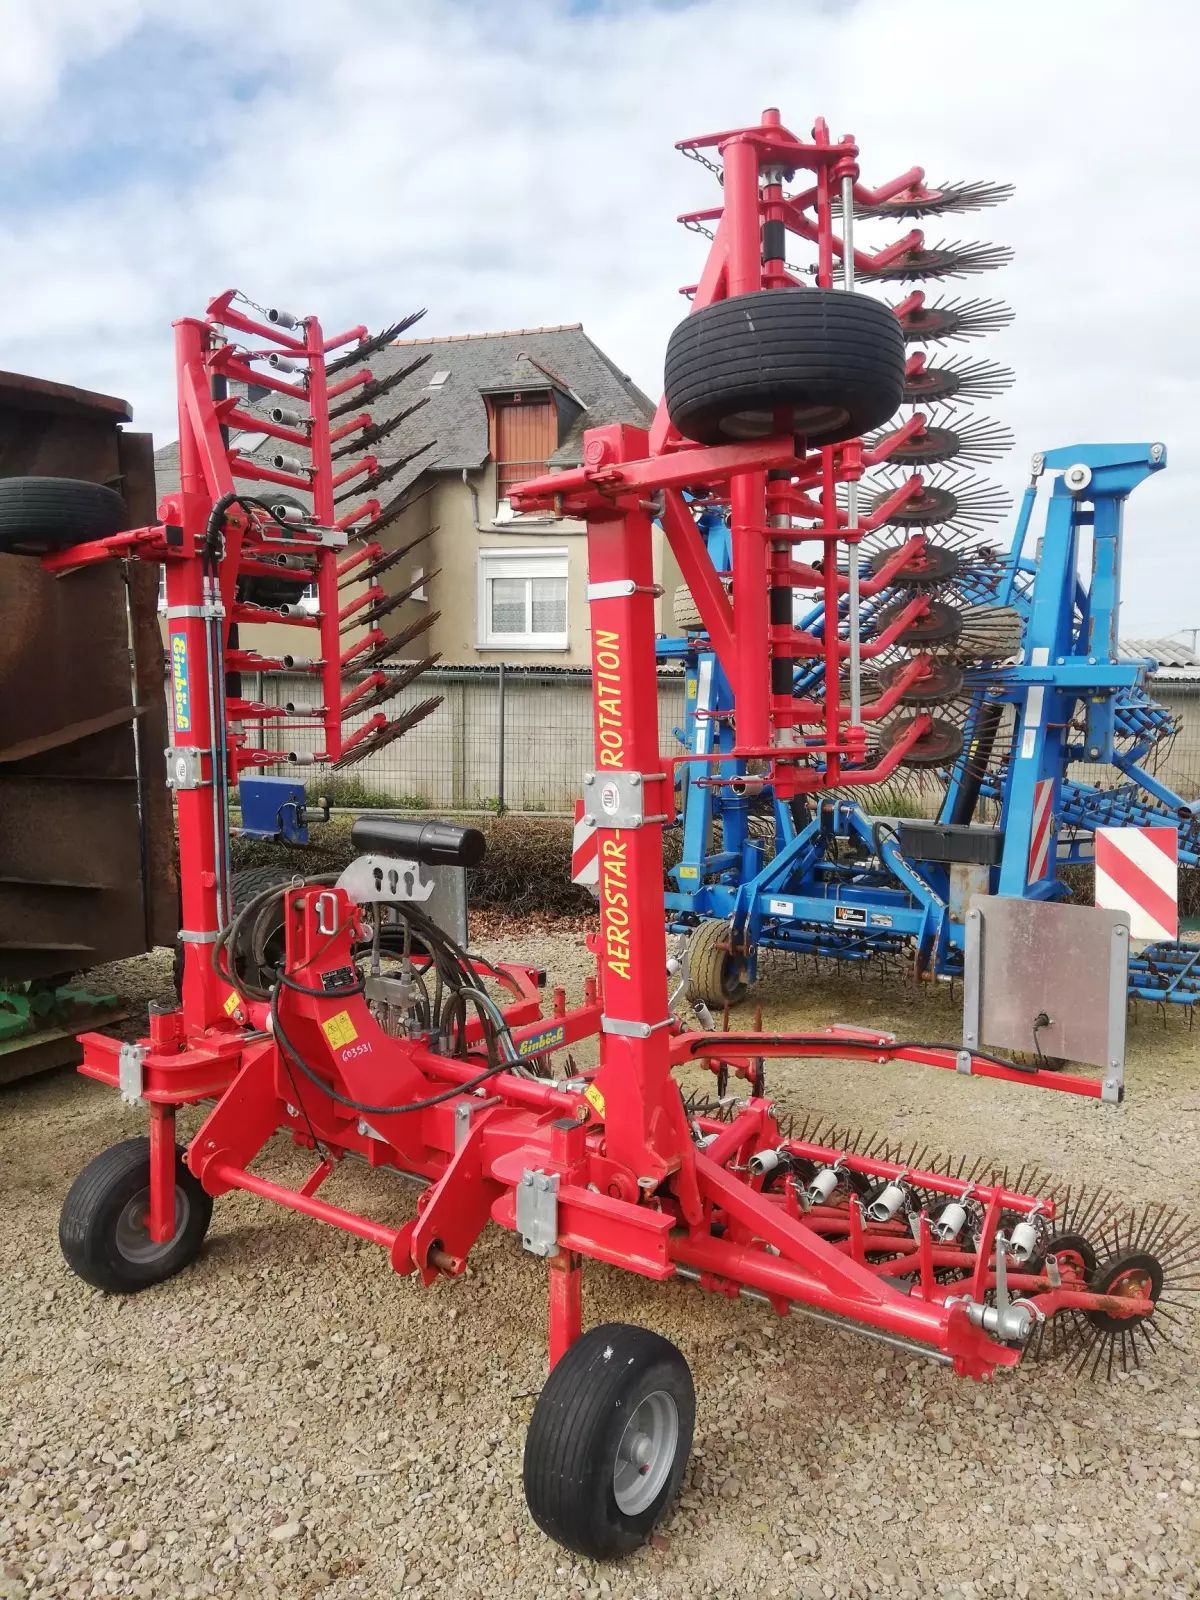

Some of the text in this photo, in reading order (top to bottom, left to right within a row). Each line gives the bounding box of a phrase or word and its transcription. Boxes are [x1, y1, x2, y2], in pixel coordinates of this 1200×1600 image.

[173, 637, 189, 729] Einböck
[596, 629, 624, 768] ROTATION
[342, 1041, 373, 1062] 603531
[519, 1026, 564, 1055] Einböck
